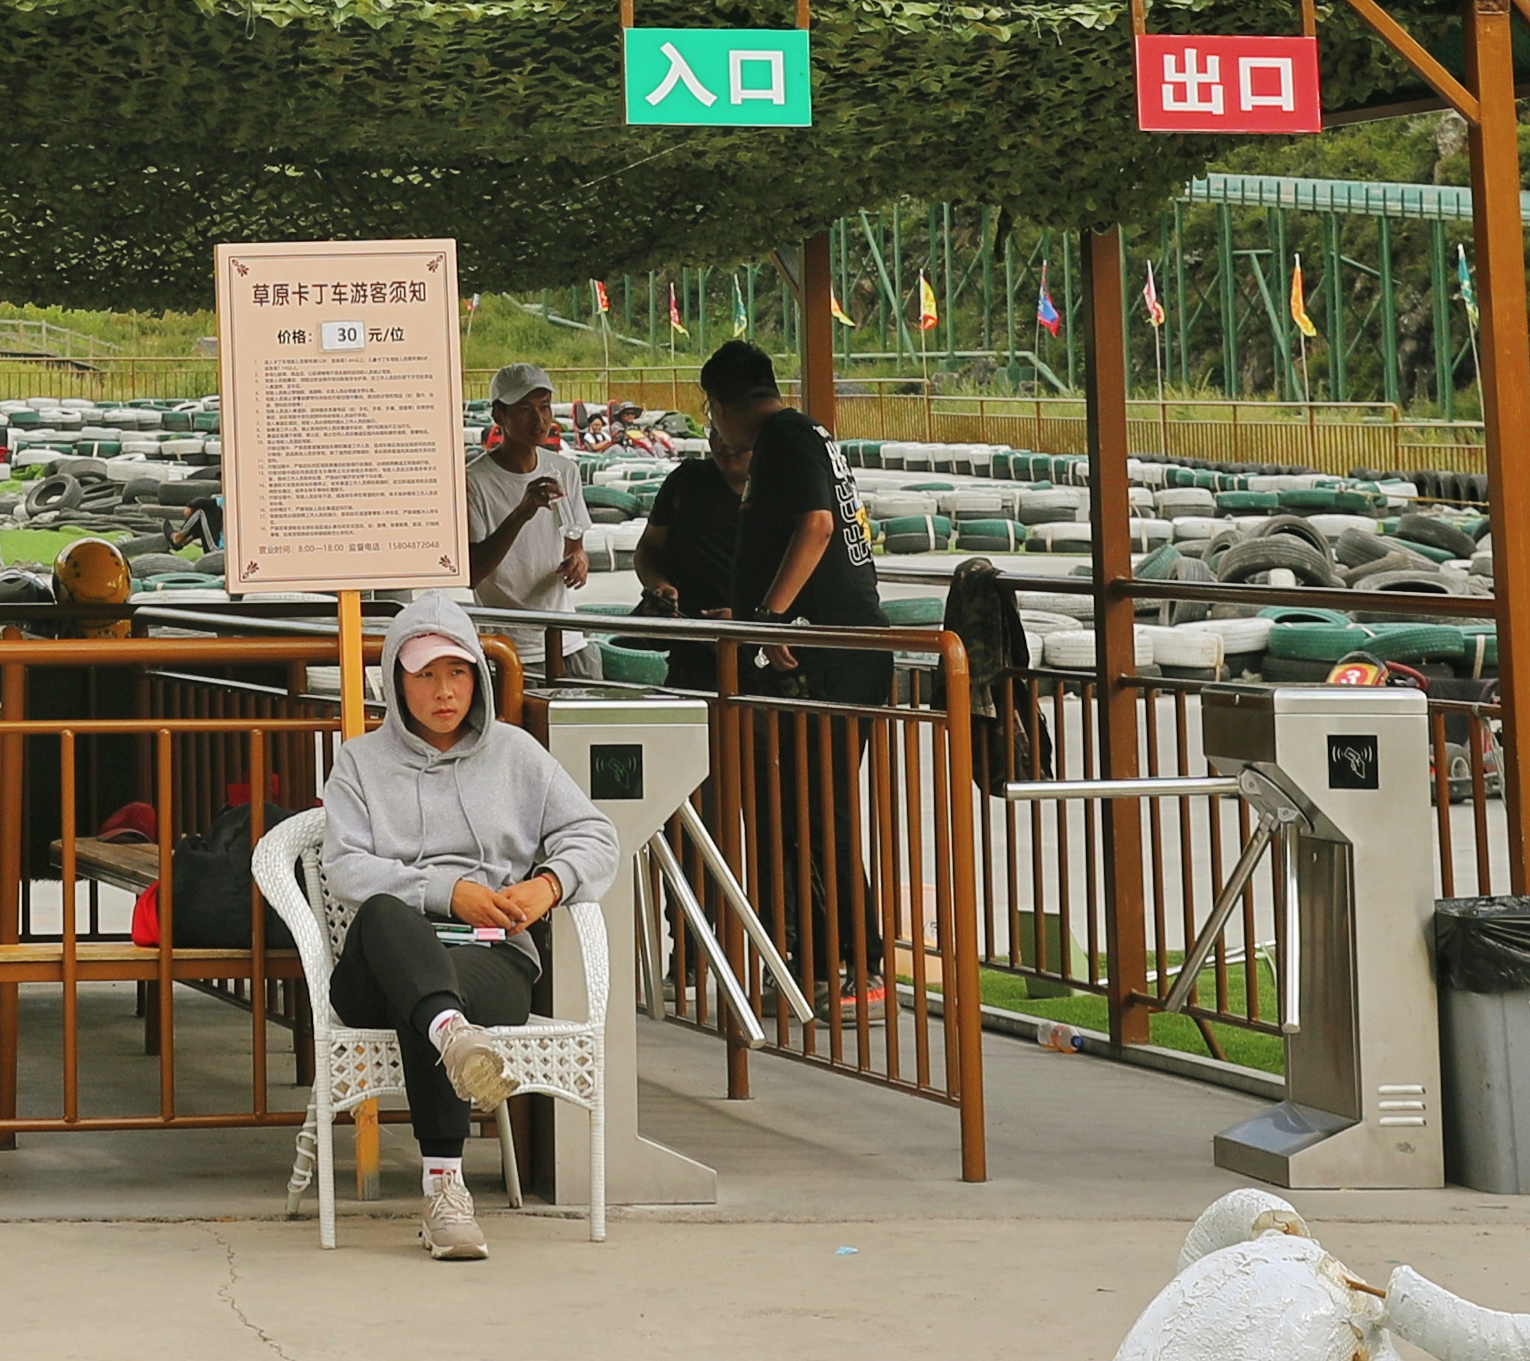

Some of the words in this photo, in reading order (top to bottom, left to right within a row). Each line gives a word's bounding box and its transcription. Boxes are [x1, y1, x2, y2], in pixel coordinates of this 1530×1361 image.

[645, 41, 786, 108] 入口
[1161, 48, 1296, 115] 出口
[252, 280, 427, 307] 草原卡丁车游客须知
[337, 327, 358, 342] 30
[368, 326, 405, 343] 元/位
